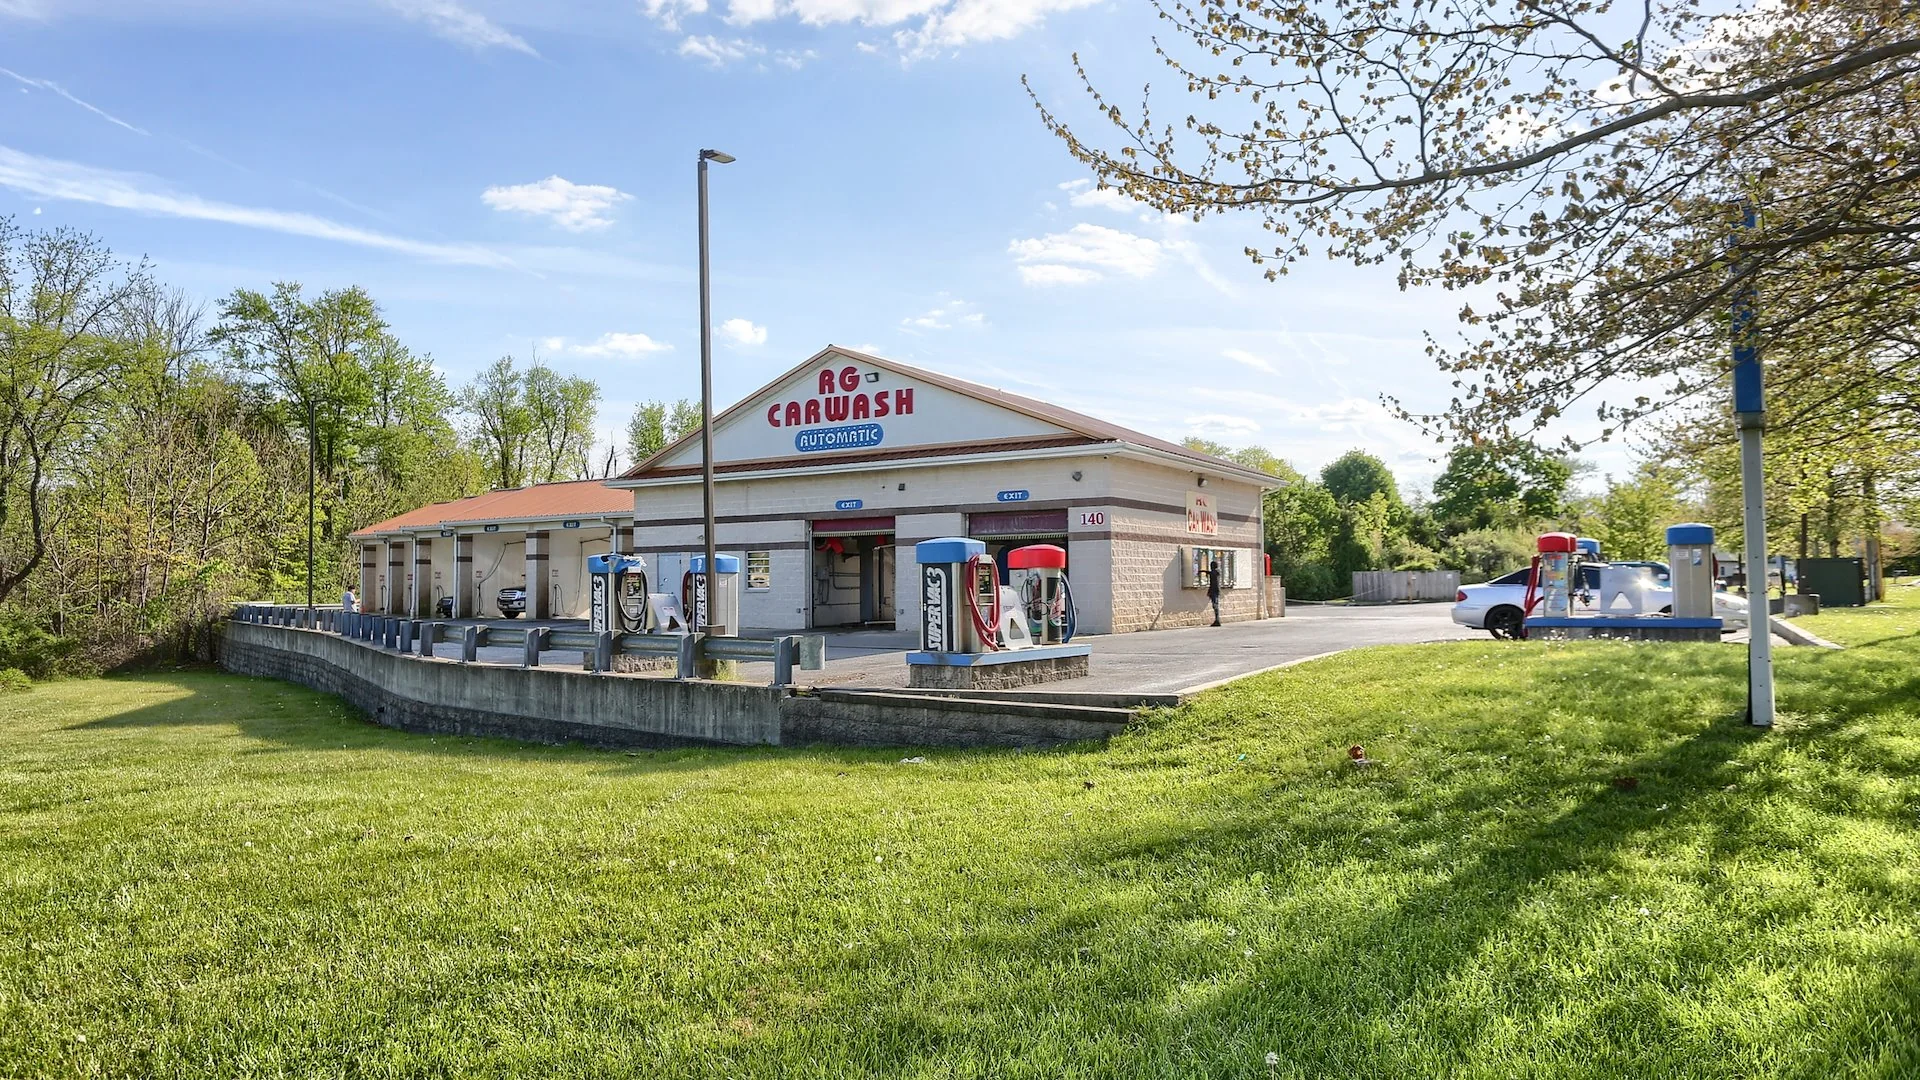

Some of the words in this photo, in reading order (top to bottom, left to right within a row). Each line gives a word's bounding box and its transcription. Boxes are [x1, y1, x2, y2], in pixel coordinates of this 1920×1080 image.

[819, 366, 861, 395] RG
[767, 388, 914, 428] CARWASH
[800, 428, 879, 447] AUTOMATIC
[1003, 492, 1023, 500] EXIT
[840, 501, 858, 509] EXIT
[1081, 512, 1104, 526] 140
